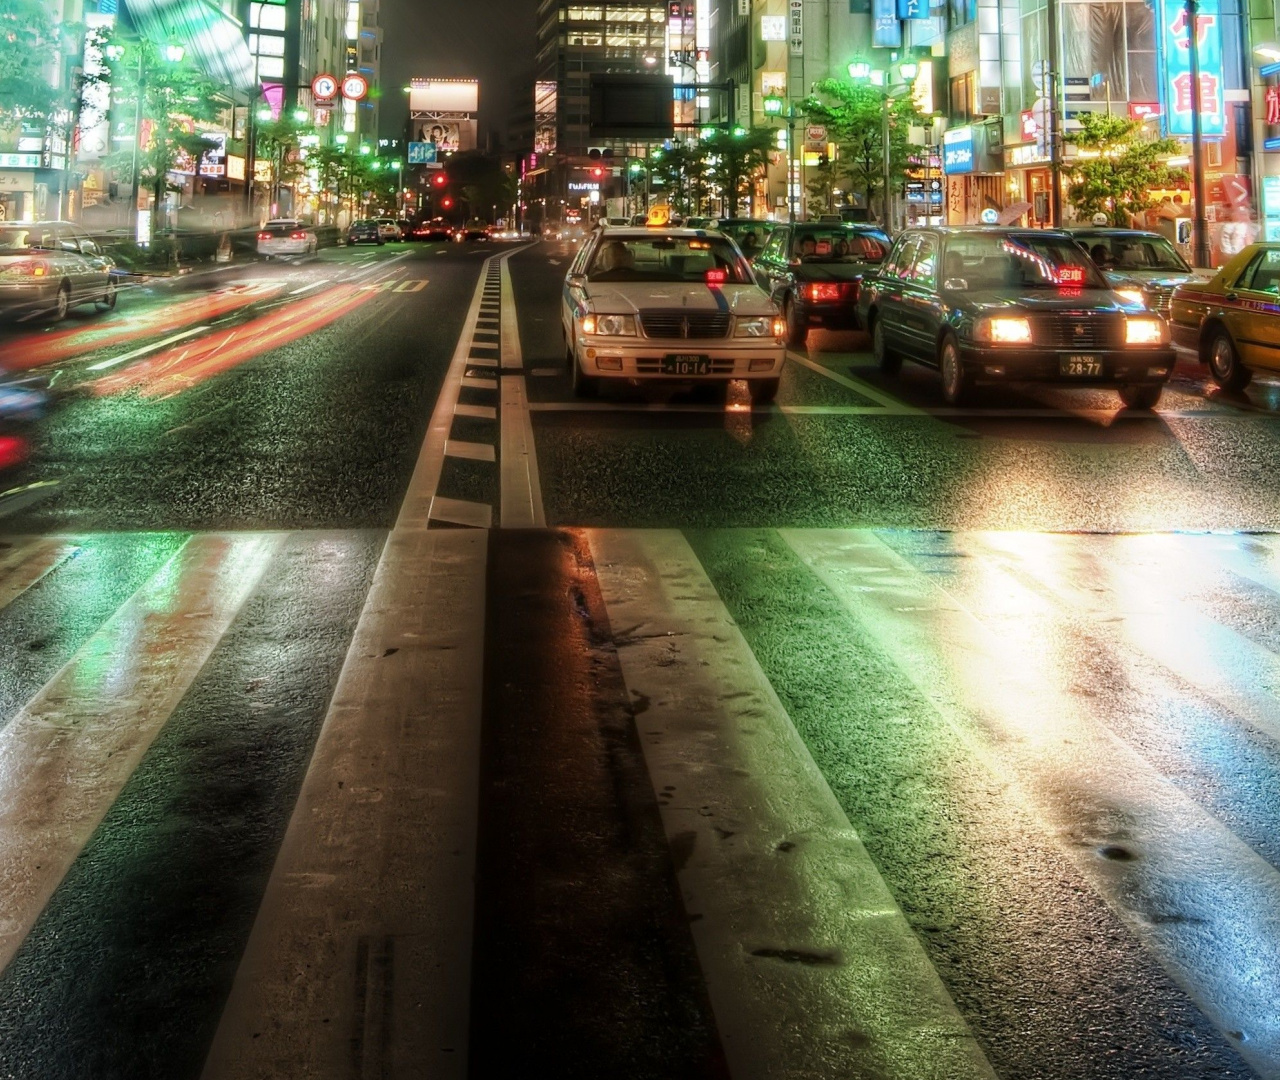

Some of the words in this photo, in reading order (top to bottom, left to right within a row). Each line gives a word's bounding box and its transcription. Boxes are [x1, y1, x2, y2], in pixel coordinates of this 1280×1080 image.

[346, 82, 362, 94] 40
[1059, 269, 1083, 281] 空車
[675, 362, 706, 374] 10-14
[1068, 363, 1101, 375] 28-77
